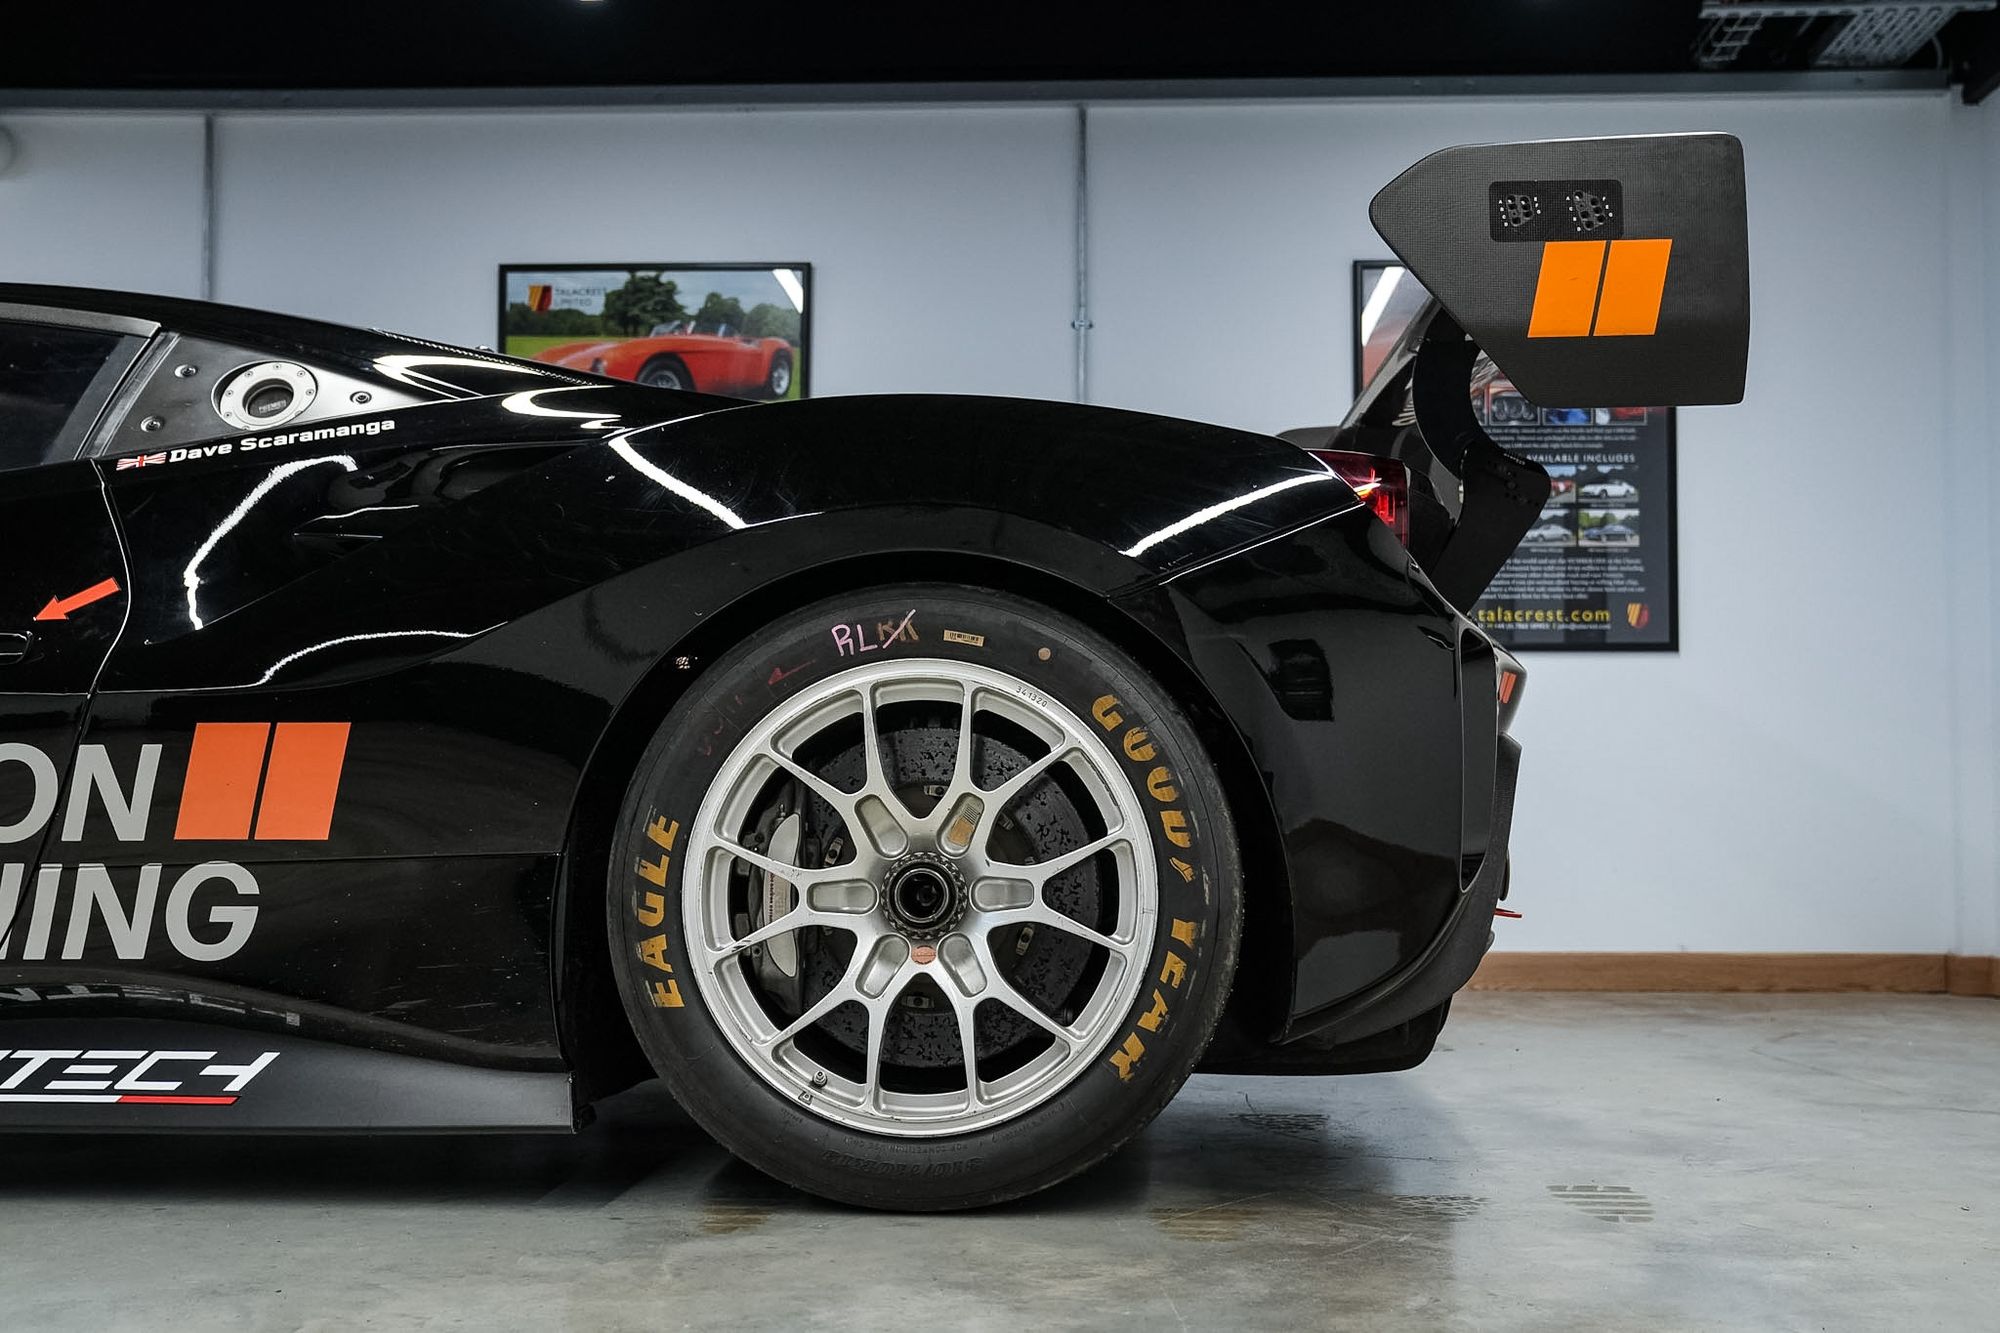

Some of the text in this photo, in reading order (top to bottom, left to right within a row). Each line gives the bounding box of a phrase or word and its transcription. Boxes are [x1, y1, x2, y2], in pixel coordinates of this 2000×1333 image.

[168, 418, 396, 463] Dave Scaramanga
[1583, 453, 1635, 463] INCLUDES
[0, 860, 260, 962] ING
[637, 815, 685, 1008] EAGLE
